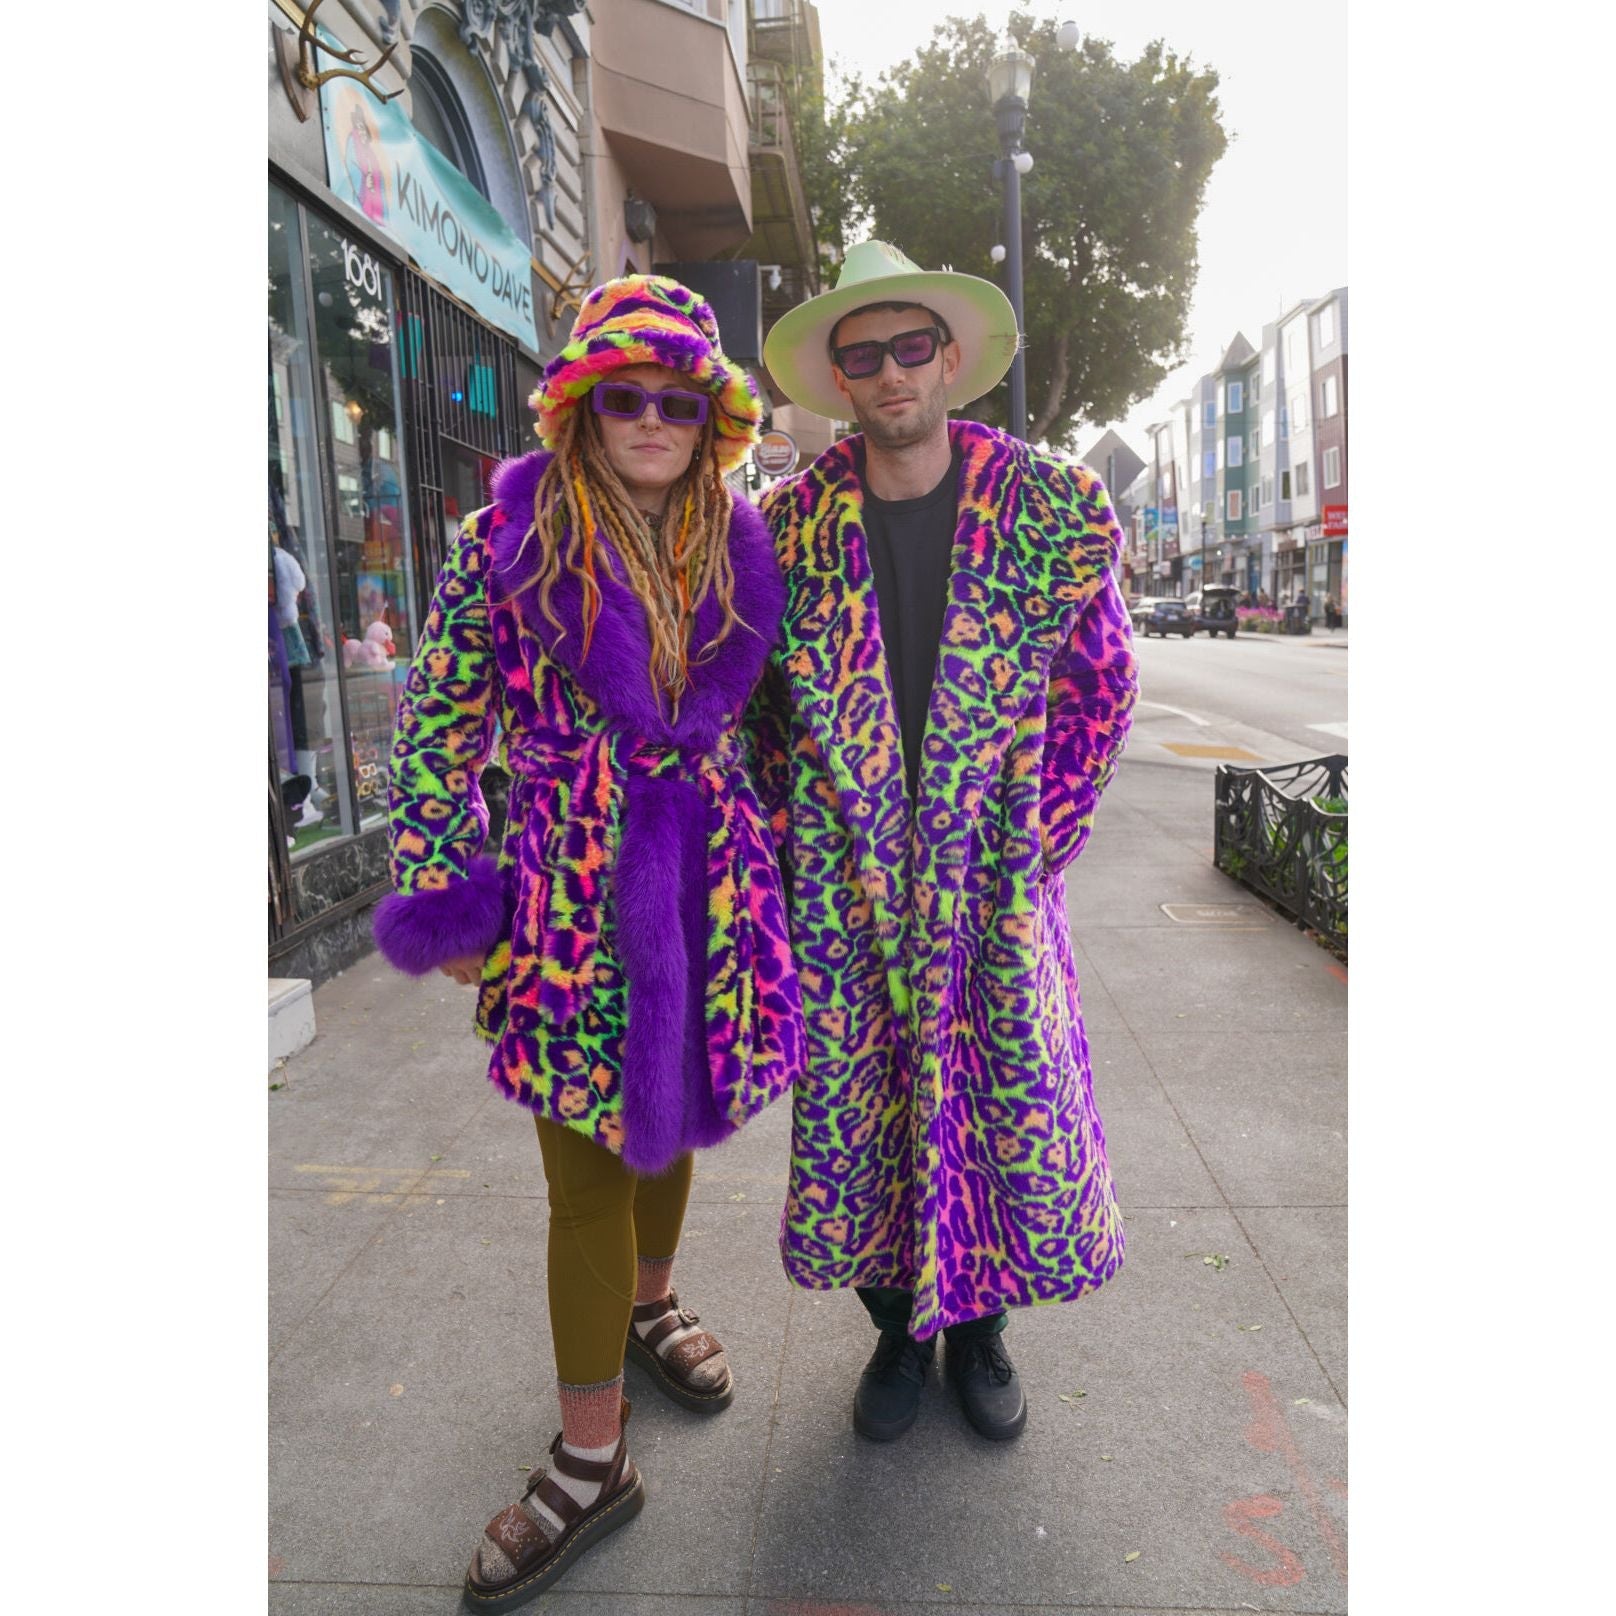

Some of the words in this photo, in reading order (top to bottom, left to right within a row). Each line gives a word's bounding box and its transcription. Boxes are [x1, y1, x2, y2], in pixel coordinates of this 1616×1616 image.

[341, 238, 382, 301] 1681
[396, 161, 489, 284] KIMONO
[492, 256, 532, 325] DAVE
